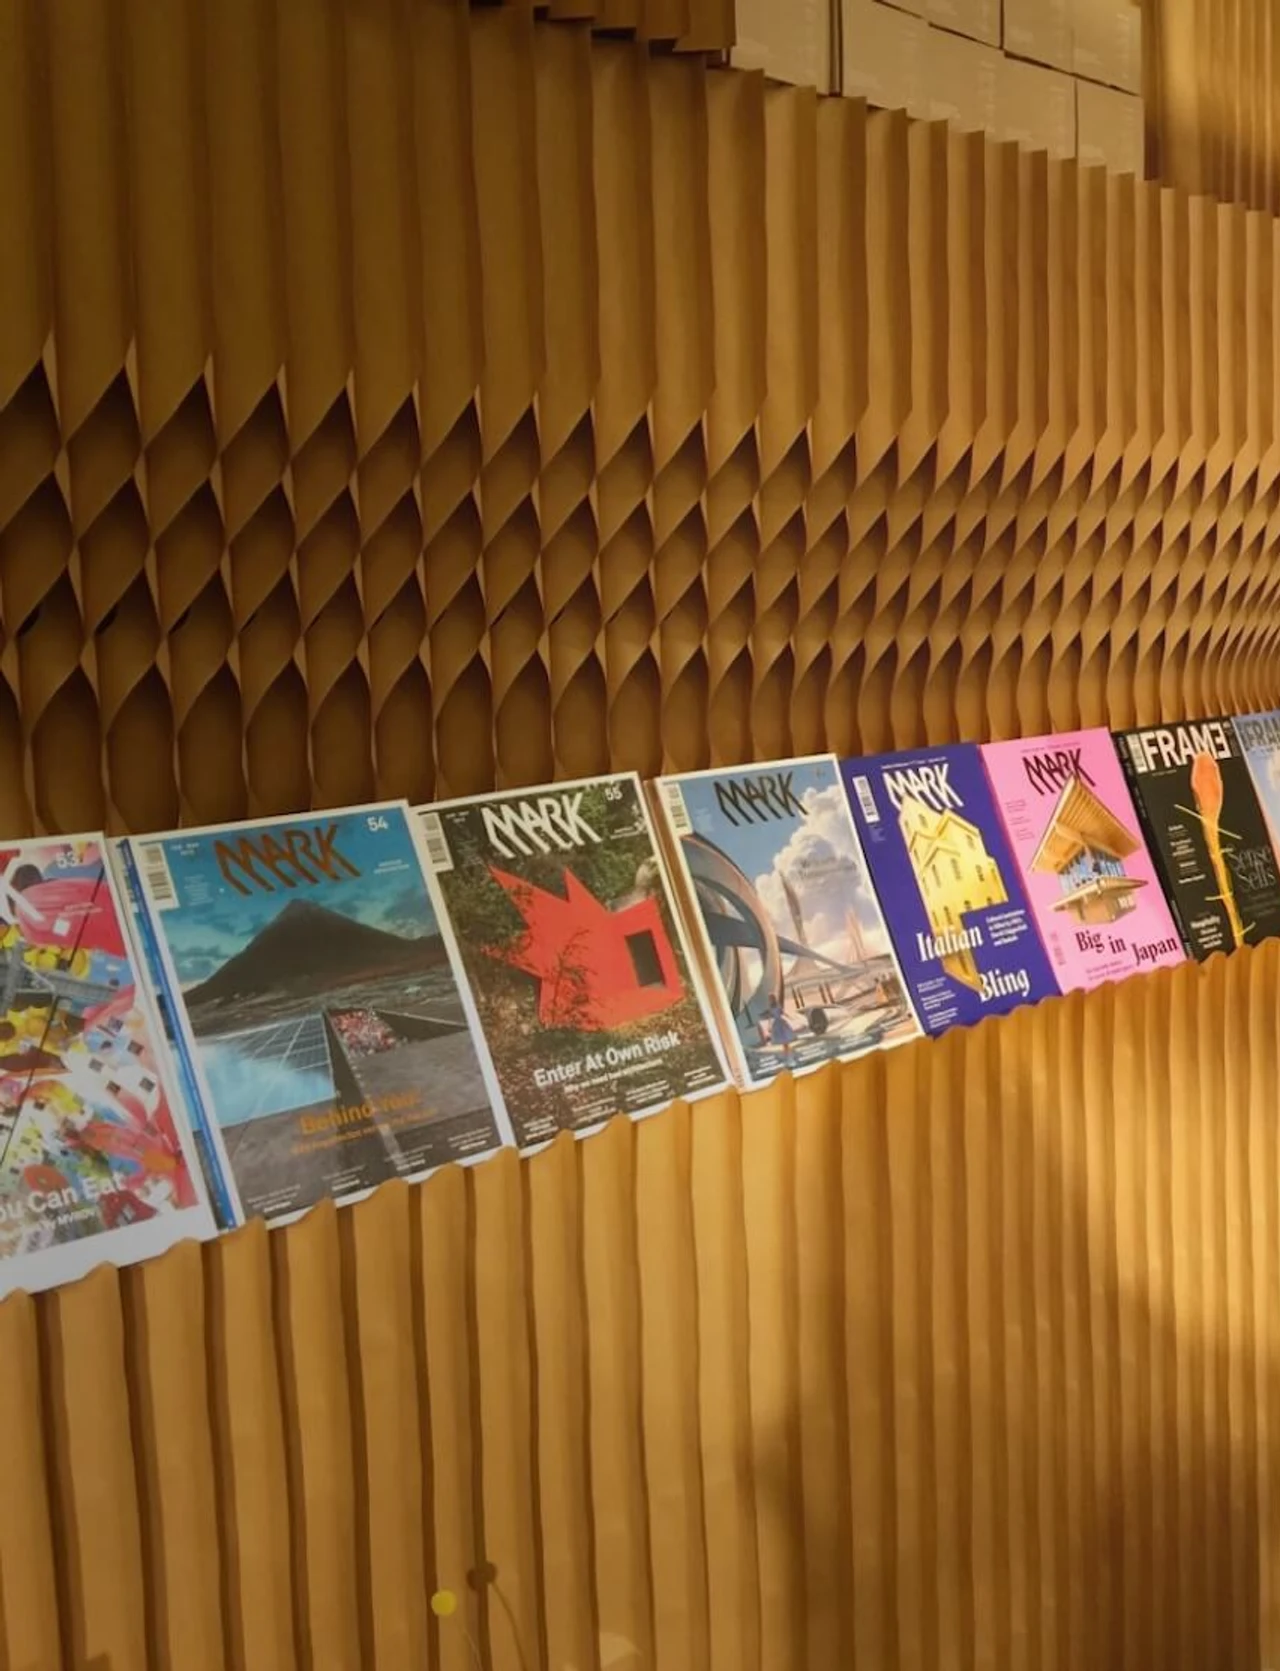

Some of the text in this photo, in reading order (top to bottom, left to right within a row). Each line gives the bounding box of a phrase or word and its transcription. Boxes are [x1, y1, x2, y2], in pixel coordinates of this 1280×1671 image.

[1140, 721, 1233, 773] FRAME
[604, 784, 623, 801] 55
[880, 763, 965, 812] MARK
[1021, 748, 1097, 796] MARK
[712, 770, 809, 827] MARK
[366, 815, 390, 833] 54
[480, 791, 603, 860] MARK
[213, 822, 363, 897] MARK
[915, 921, 985, 963] Italian
[1074, 929, 1179, 968] Big in Japan
[979, 968, 1032, 1003] Bling
[533, 1030, 682, 1088] Enter At Own Risk
[300, 1103, 375, 1136] Behind
[0, 1198, 24, 1224] ou
[27, 1186, 79, 1214] Can
[82, 1171, 127, 1200] Eat
